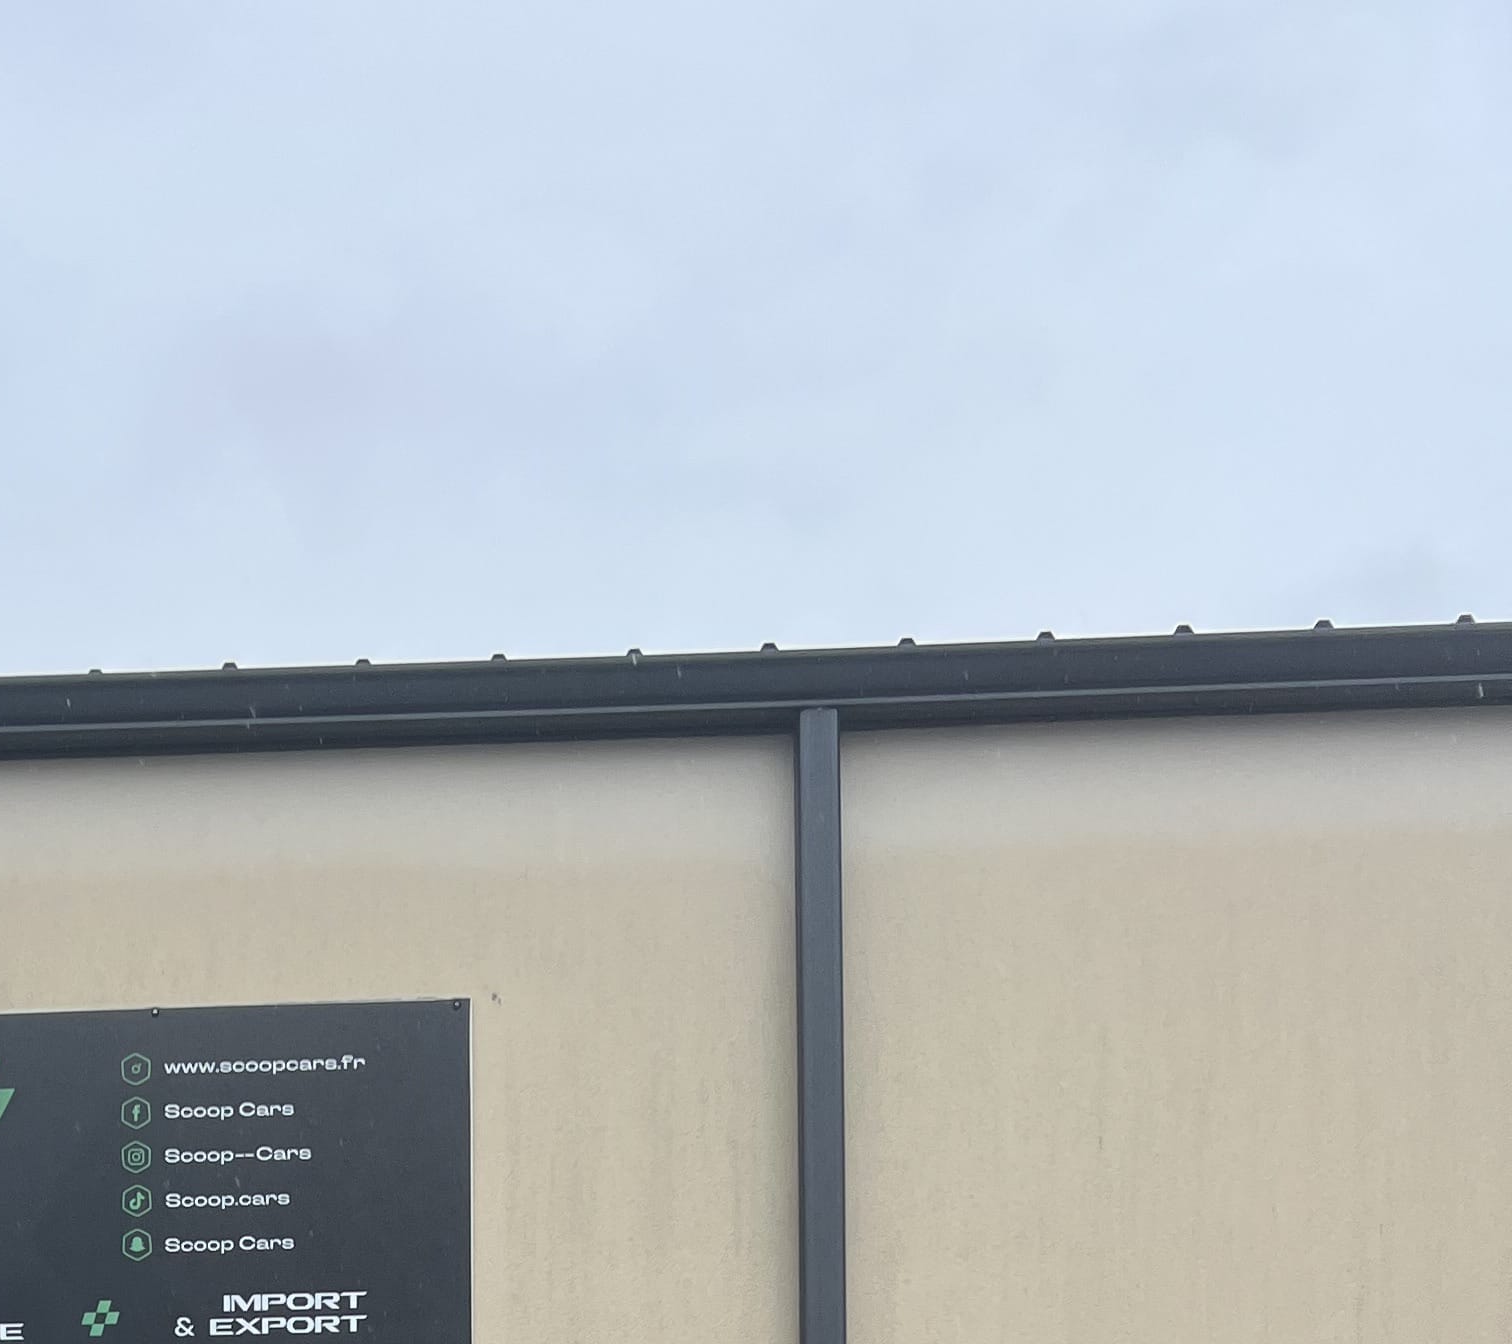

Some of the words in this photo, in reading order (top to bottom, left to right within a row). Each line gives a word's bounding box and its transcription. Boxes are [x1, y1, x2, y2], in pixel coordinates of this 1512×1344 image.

[164, 1054, 366, 1075] www.scoopcars.fr
[164, 1103, 234, 1121] Scoop
[238, 1101, 295, 1117] Cars
[165, 1193, 290, 1210] Scoop.cars
[164, 1237, 235, 1255] Scoop
[238, 1235, 295, 1251] Cars
[223, 1291, 368, 1313] IMPORT
[174, 1316, 195, 1337] &
[209, 1314, 368, 1336] EXPORT
